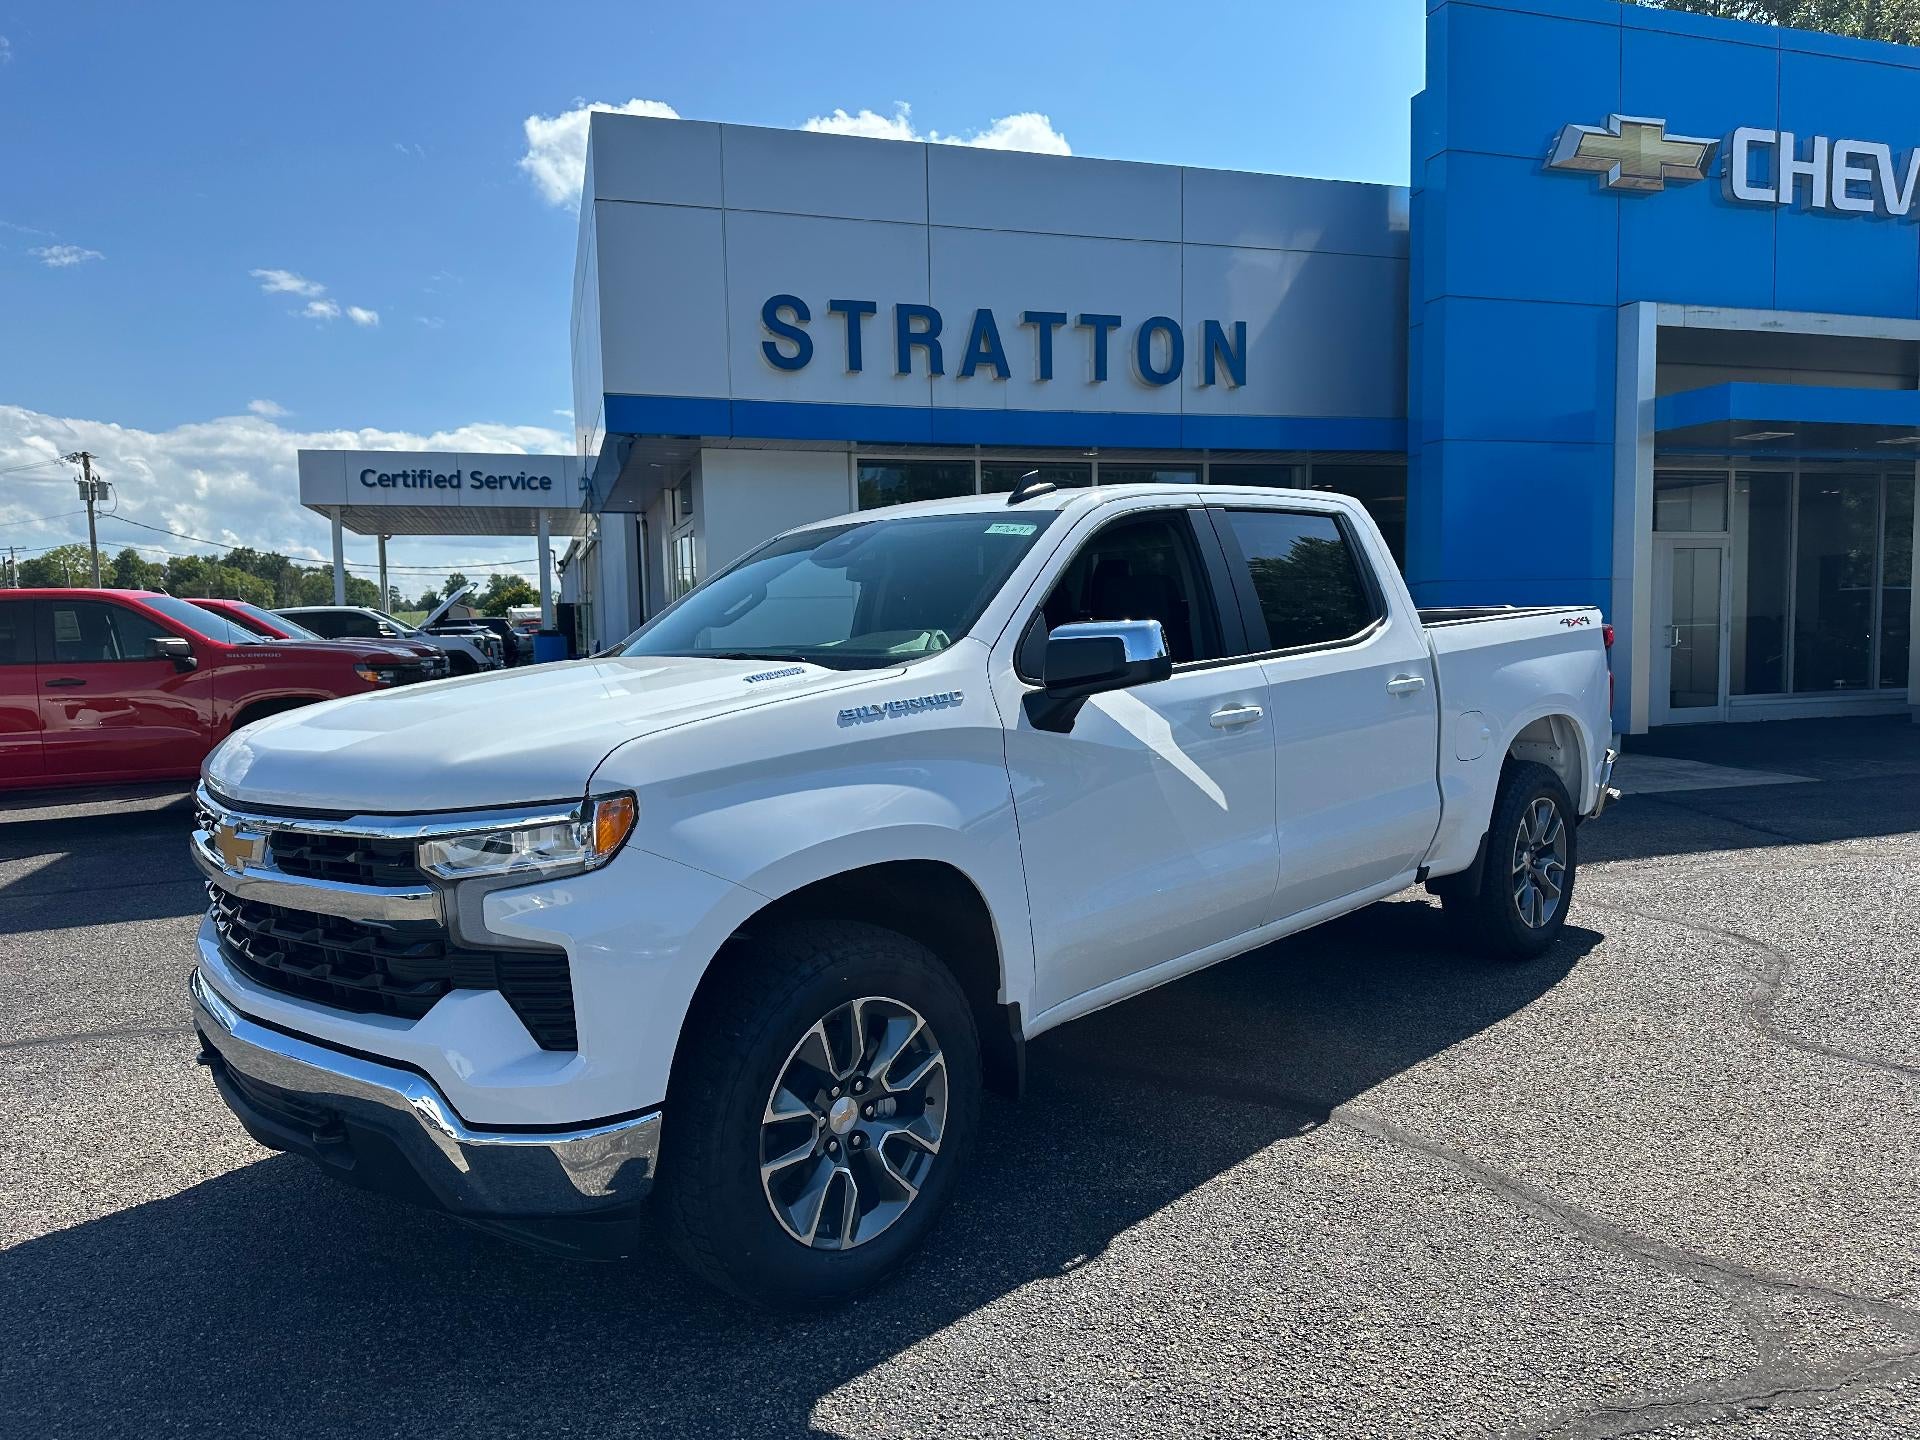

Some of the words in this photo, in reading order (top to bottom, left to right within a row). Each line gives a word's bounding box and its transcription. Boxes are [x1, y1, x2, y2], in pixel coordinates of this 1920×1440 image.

[1723, 126, 1920, 217] CHEV
[760, 294, 1247, 389] STRATTON
[360, 468, 462, 490] Certified
[470, 470, 552, 490] Service
[838, 690, 964, 721] SILVERADO
